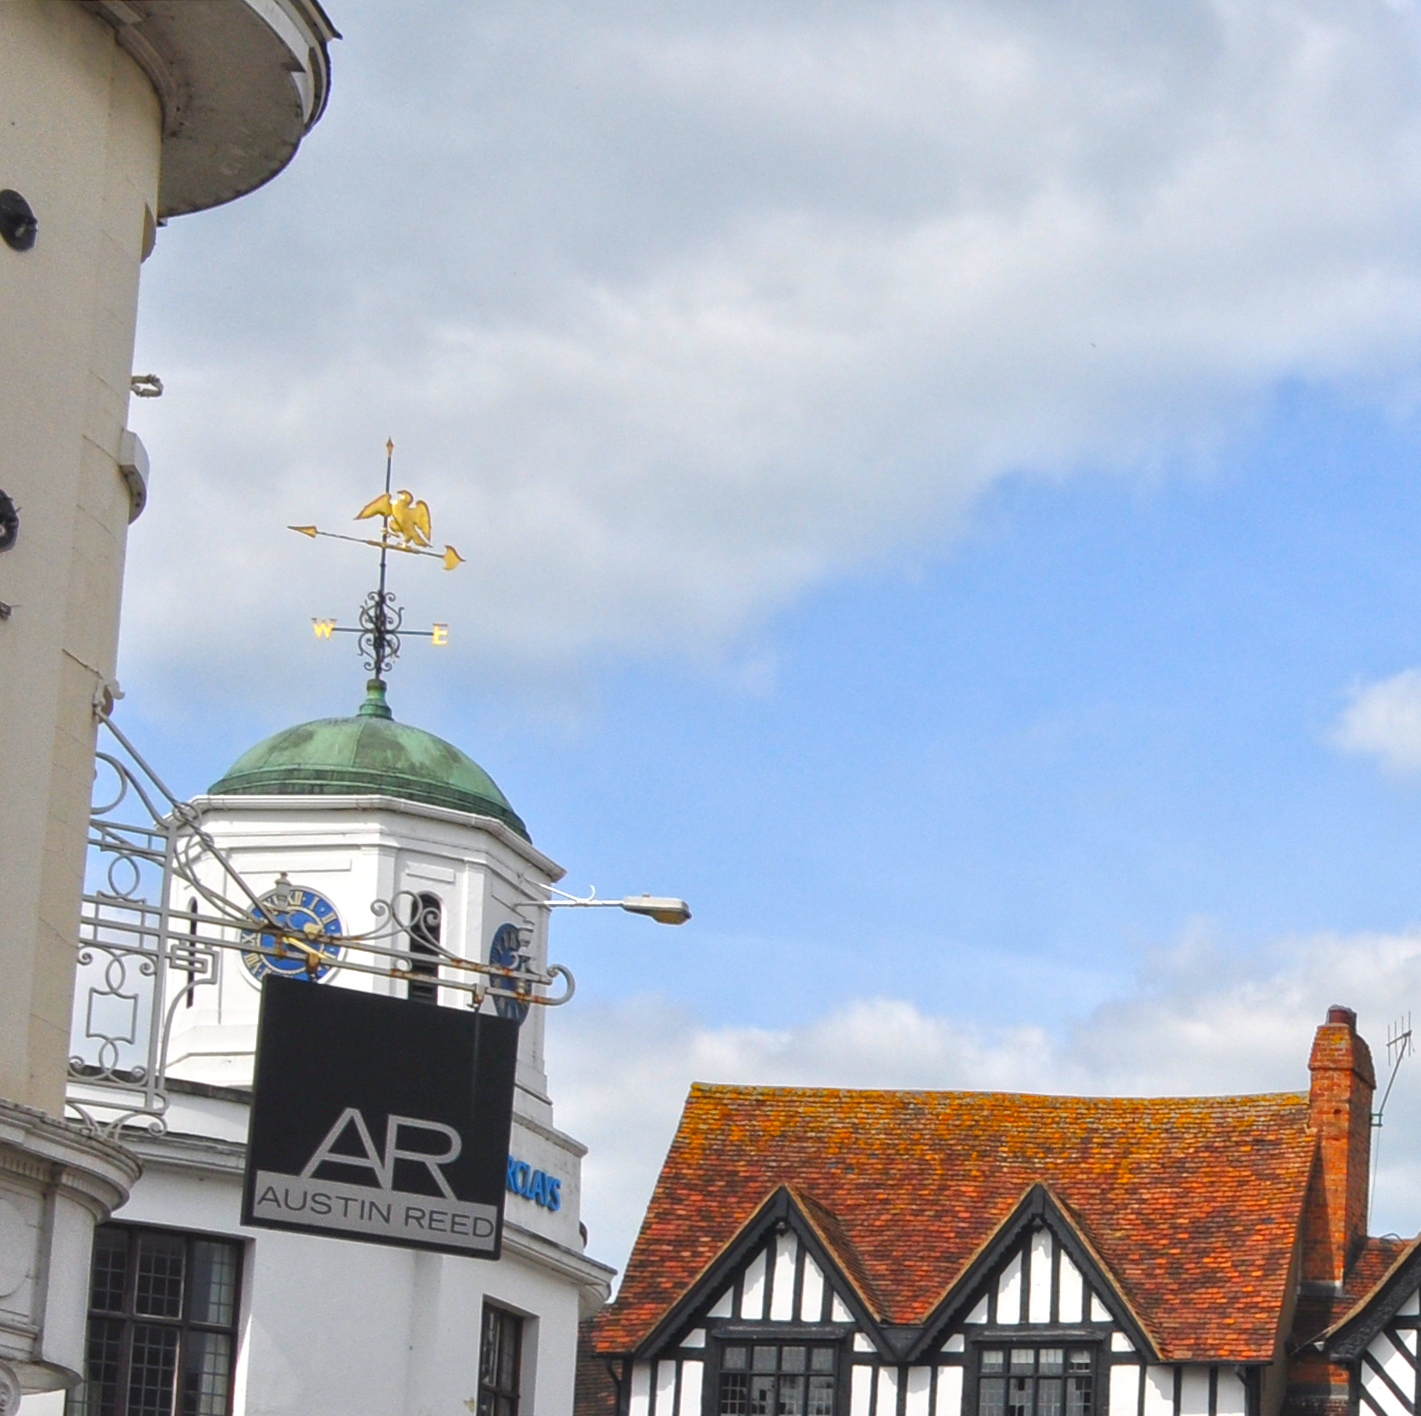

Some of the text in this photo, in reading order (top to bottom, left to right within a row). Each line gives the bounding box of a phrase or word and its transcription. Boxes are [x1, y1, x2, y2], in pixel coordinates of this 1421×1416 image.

[299, 1107, 462, 1200] AR
[257, 1185, 494, 1239] AUSTIN REED
[506, 1155, 562, 1212] RCLAYS
